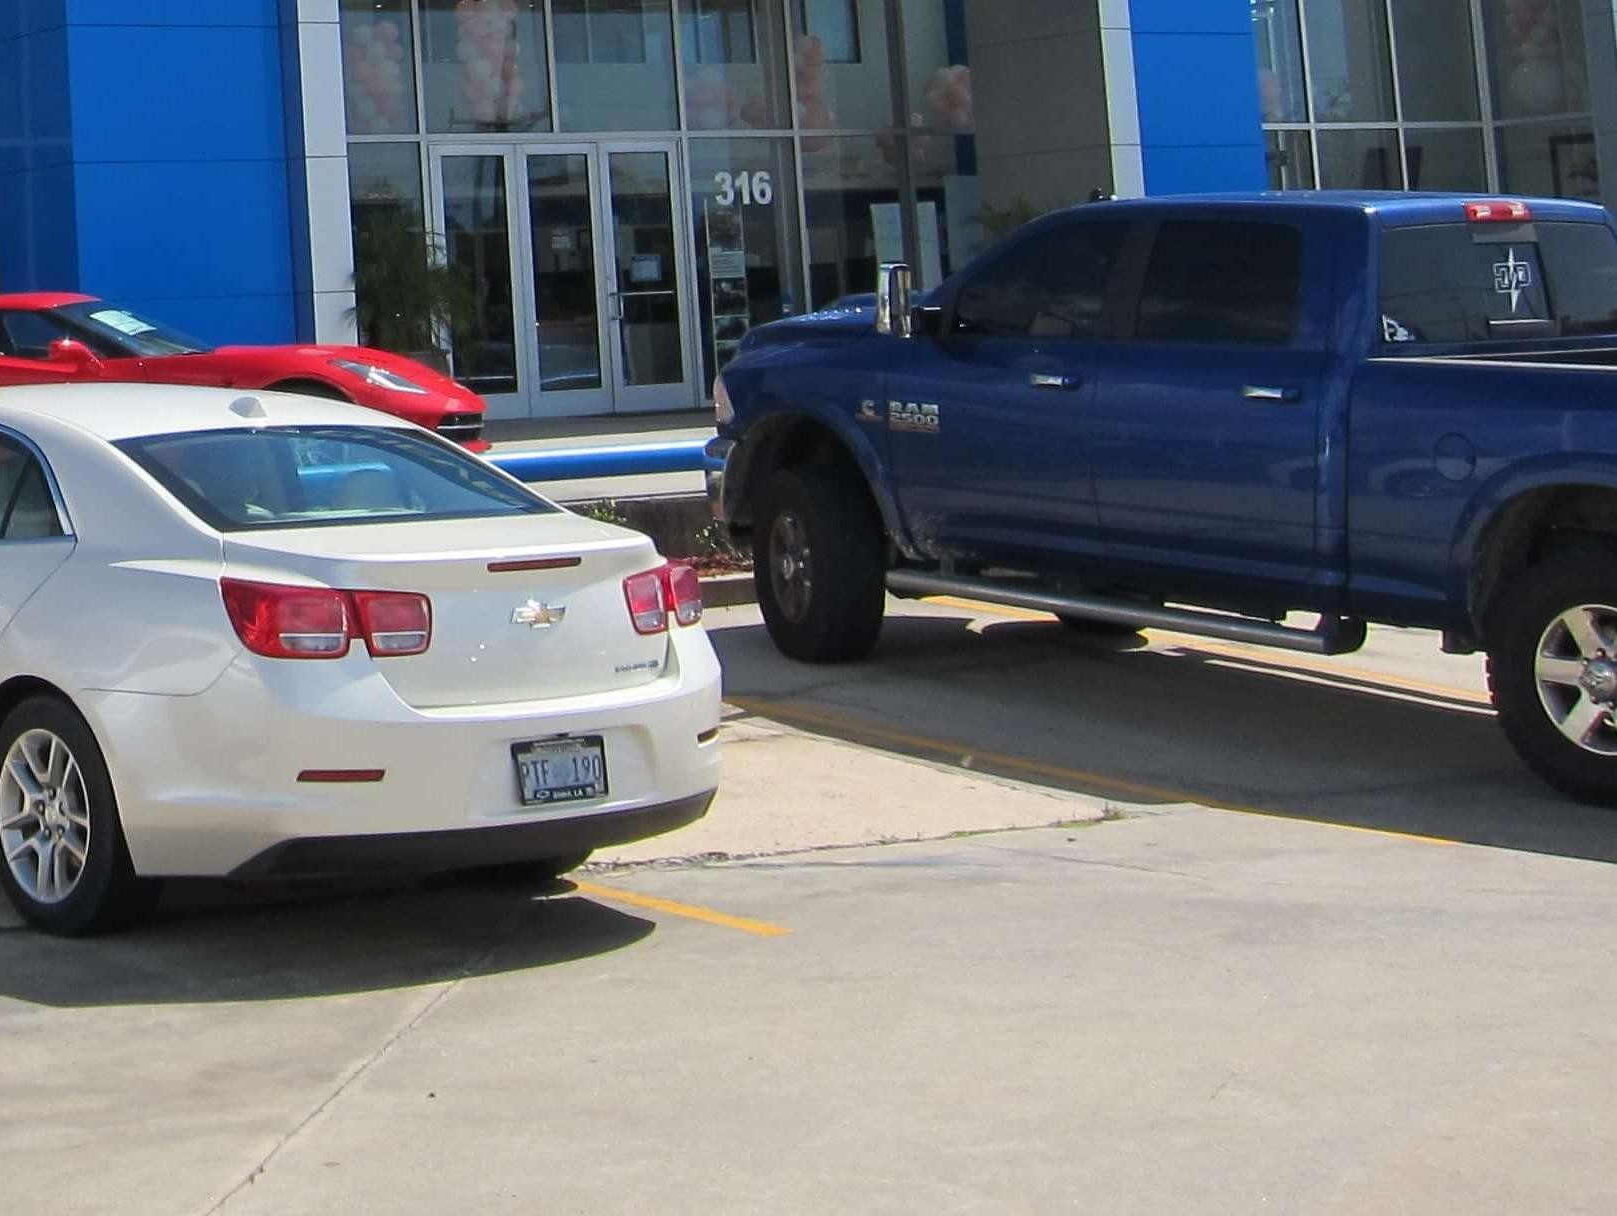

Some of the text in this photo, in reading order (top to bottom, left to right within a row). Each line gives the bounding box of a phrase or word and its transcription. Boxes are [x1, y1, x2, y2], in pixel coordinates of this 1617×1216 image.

[714, 170, 773, 205] 316
[889, 401, 939, 414] RAM
[889, 412, 939, 425] 2500
[572, 754, 602, 782] 190
